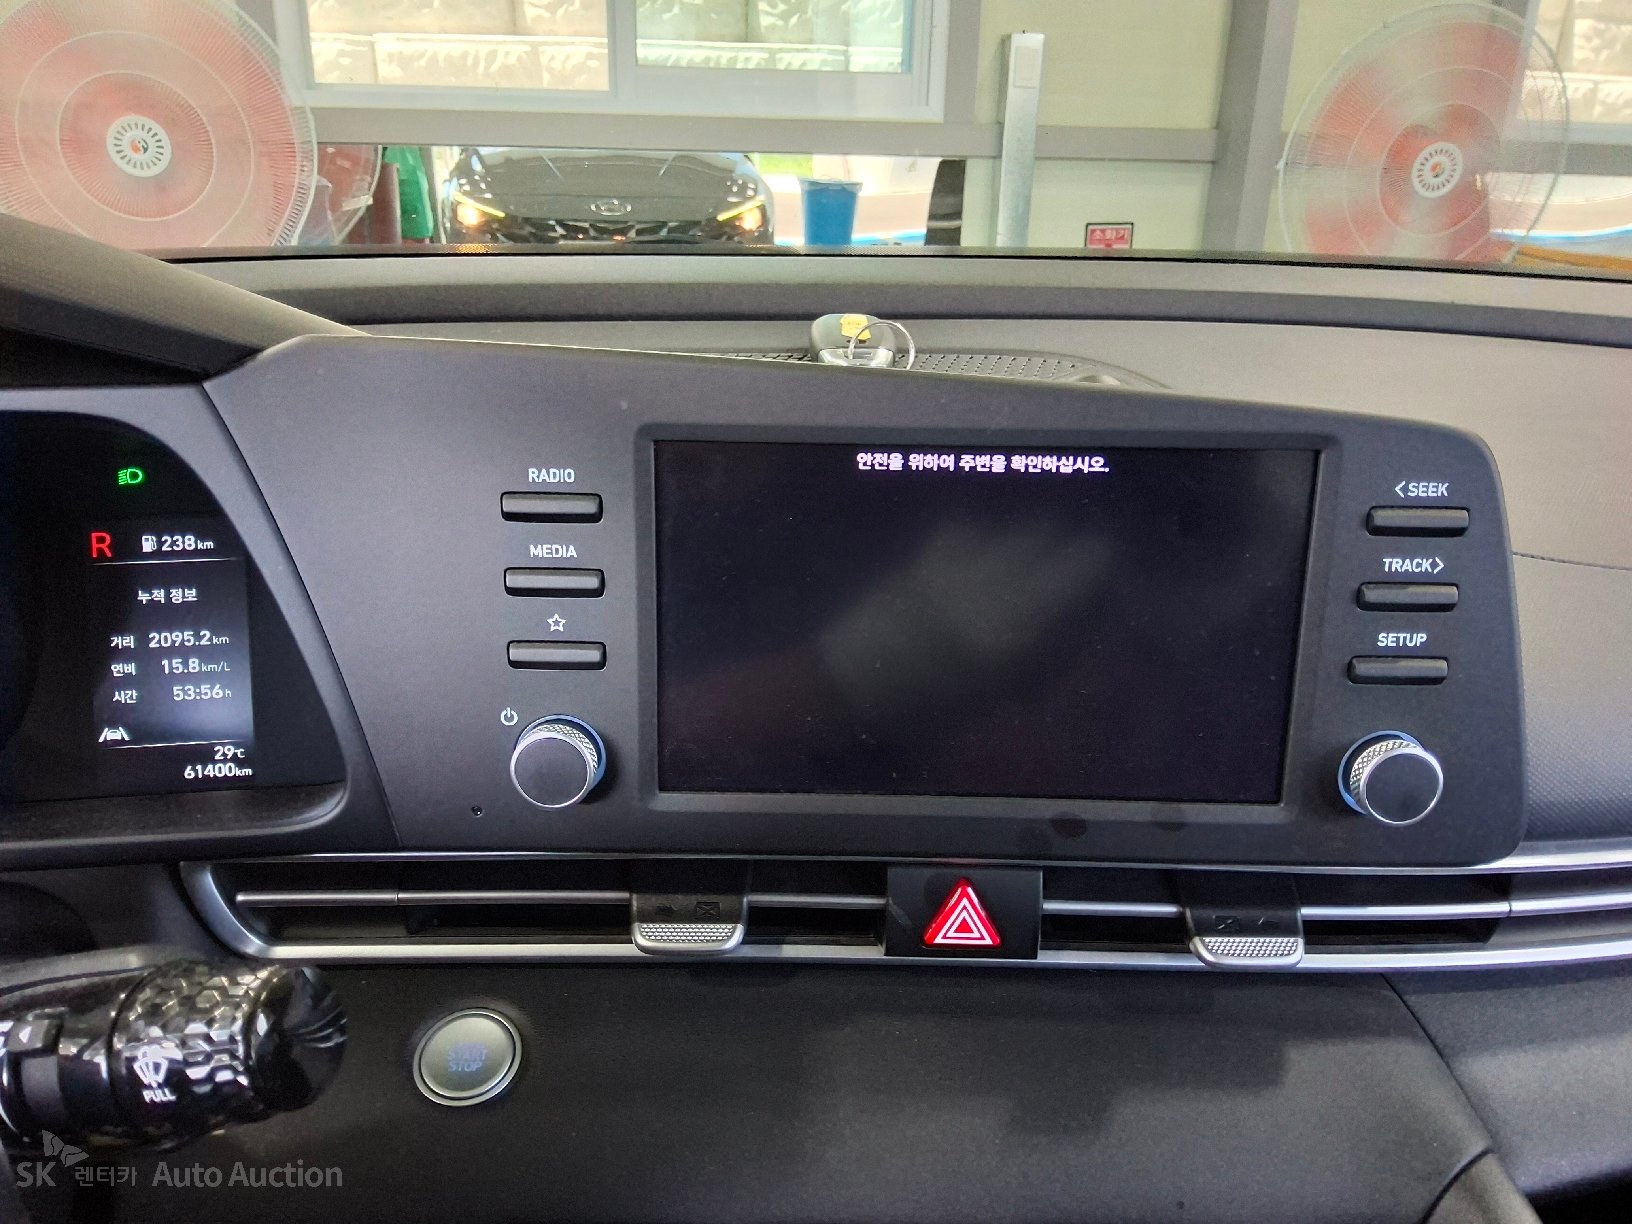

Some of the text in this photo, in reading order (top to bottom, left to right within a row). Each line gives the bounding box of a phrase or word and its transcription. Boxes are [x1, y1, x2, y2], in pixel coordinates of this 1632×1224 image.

[856, 452, 1110, 473] 안전을 위하여 주변을 확인하십시오.
[528, 468, 575, 482] RADIO
[90, 532, 112, 558] R
[529, 544, 577, 558] MEDIA
[137, 588, 198, 604] 누적 정보
[110, 635, 135, 649] 거리
[1377, 633, 1427, 647] SETUP
[110, 662, 136, 676] 연비
[112, 689, 138, 704] 시간
[448, 1059, 483, 1073] STOP
[142, 1089, 176, 1103] PULL
